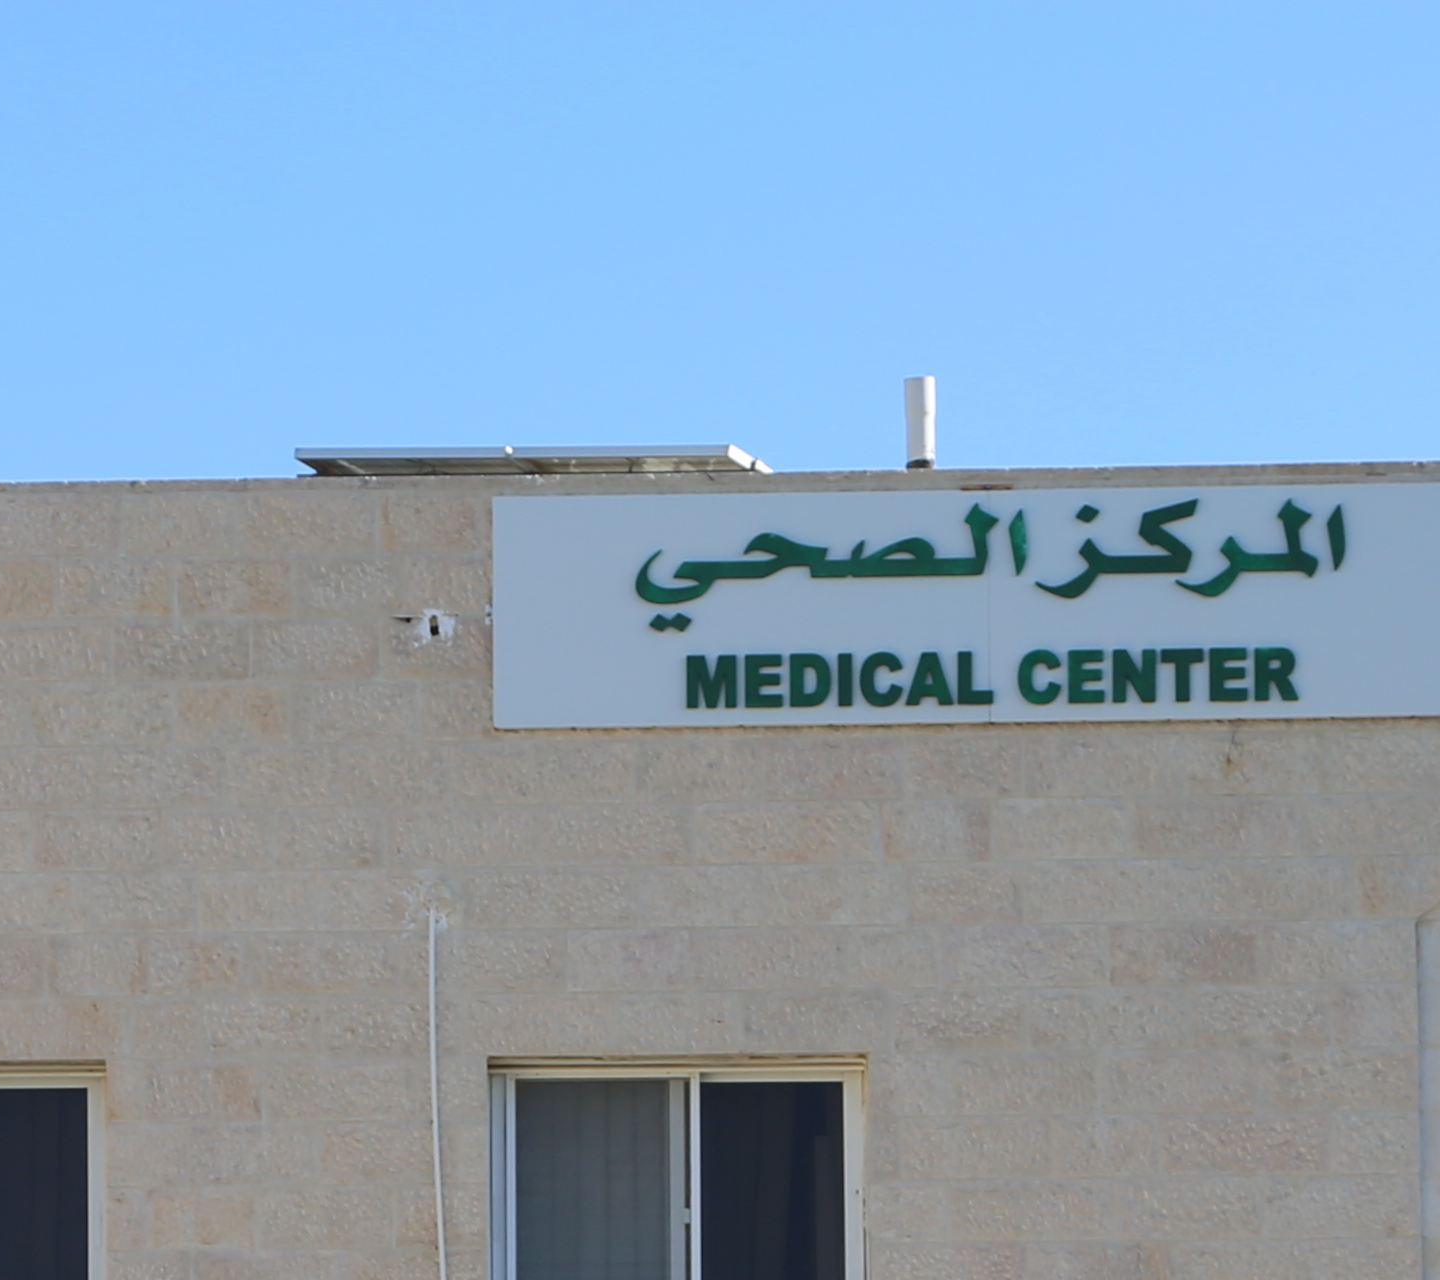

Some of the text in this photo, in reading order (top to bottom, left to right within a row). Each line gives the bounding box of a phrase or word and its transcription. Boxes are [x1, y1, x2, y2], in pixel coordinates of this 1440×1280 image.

[634, 498, 1347, 631] المركز الصحي
[685, 646, 1300, 708] MEDICAL CENTER
